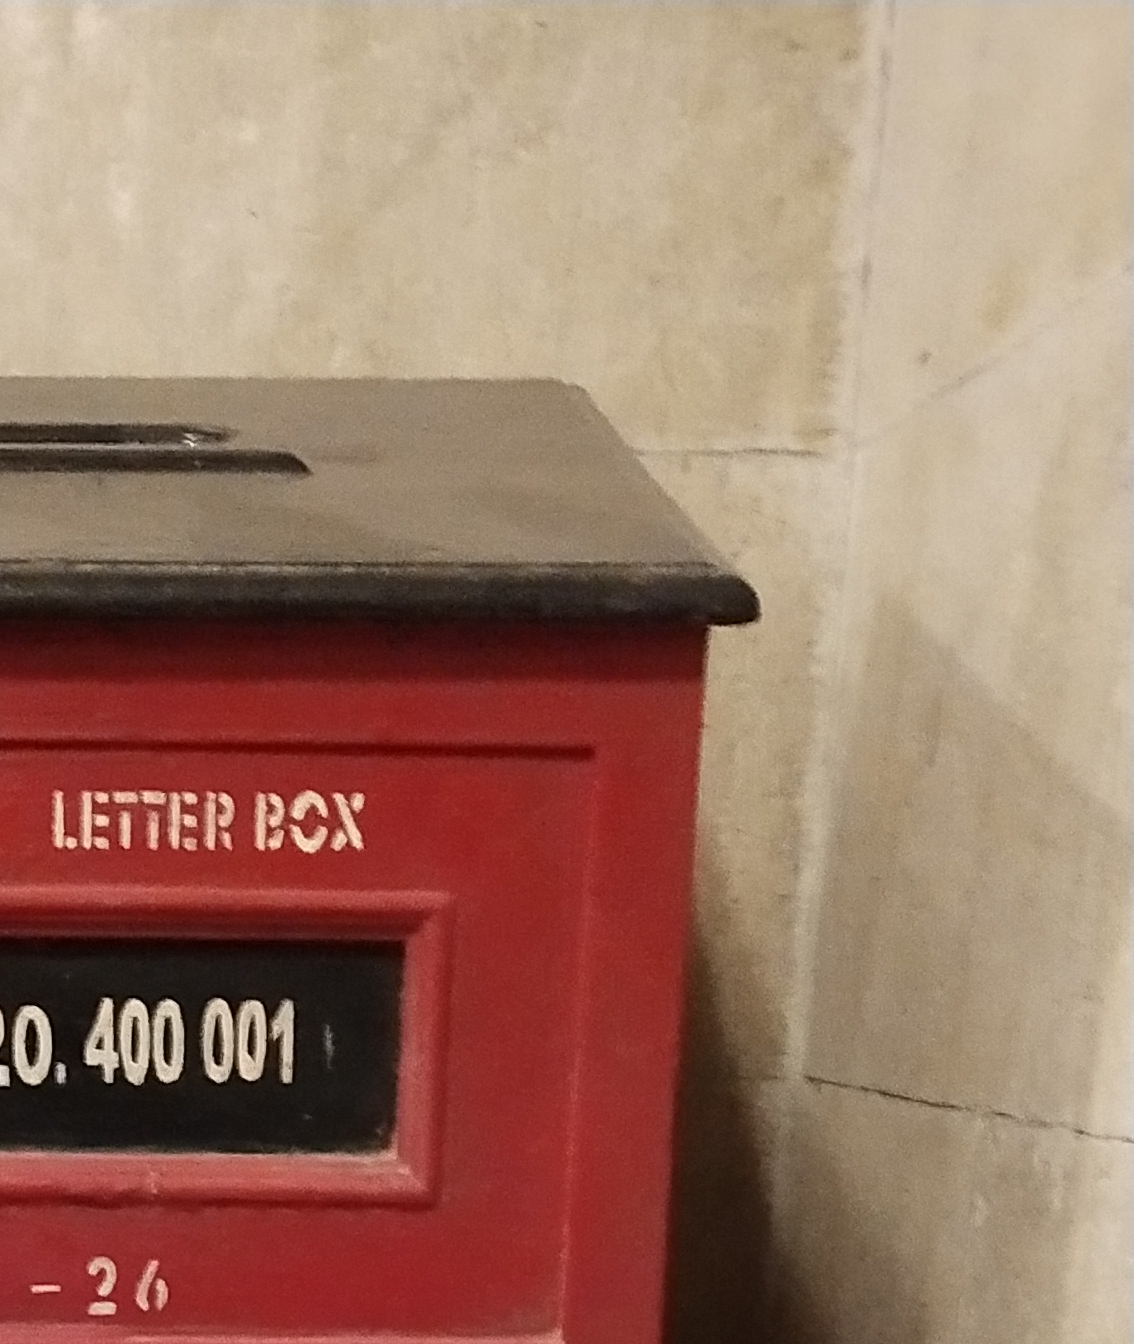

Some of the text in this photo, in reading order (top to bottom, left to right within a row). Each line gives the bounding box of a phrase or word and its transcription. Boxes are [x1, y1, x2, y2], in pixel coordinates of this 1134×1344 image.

[51, 790, 366, 854] LETTER BOX
[83, 997, 185, 1085] 400
[200, 997, 296, 1084] 001
